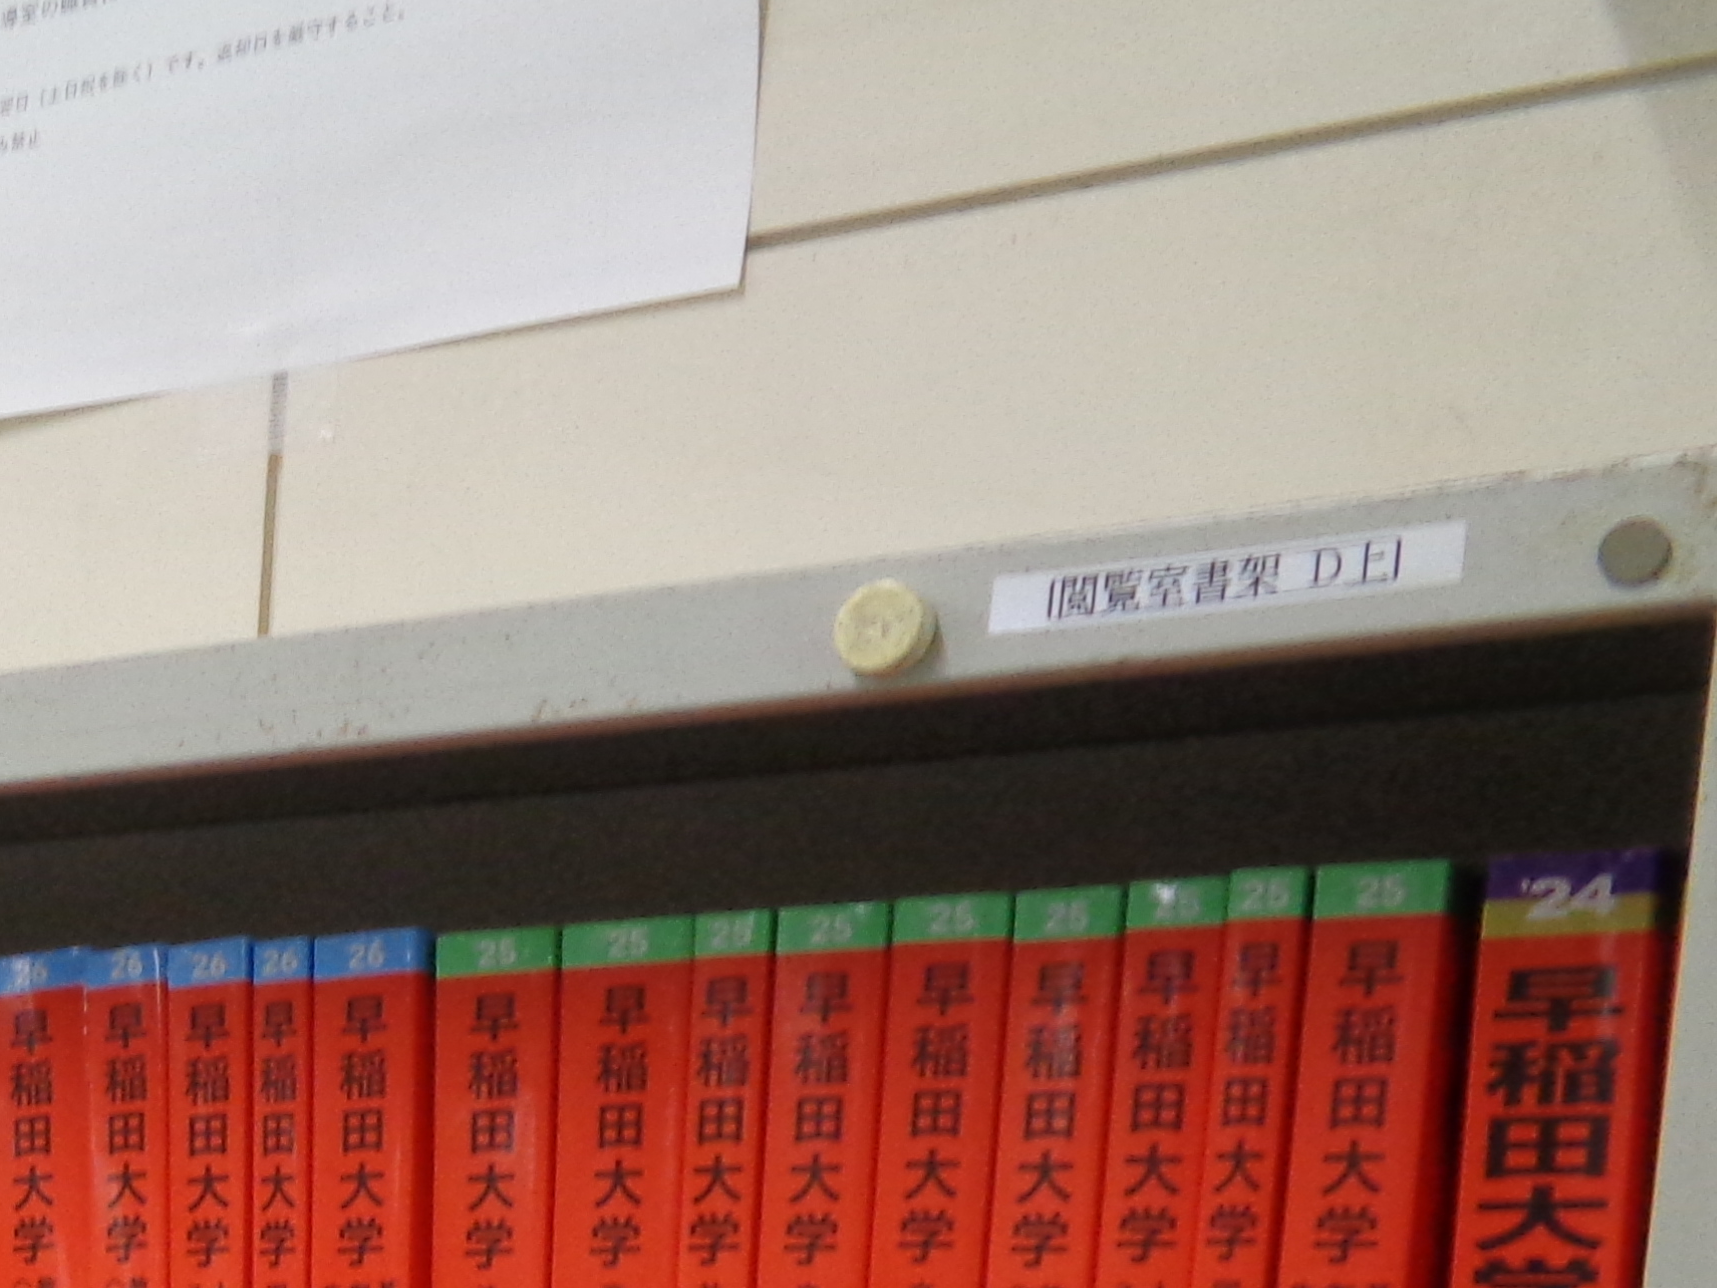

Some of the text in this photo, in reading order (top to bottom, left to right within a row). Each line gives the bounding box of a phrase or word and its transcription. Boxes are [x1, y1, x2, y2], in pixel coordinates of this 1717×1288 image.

[463, 992, 520, 1271] 早稲田大学
[590, 984, 649, 1271] 早稲田大学
[687, 976, 751, 1271] 早稲田大学
[783, 969, 853, 1265] 早稲田大学
[896, 958, 972, 1265] 早稲田大学
[1009, 960, 1086, 1267] 早稲田大学
[1116, 949, 1196, 1265] 早稲田大学
[1204, 940, 1283, 1261] 早稲田大学
[1313, 940, 1402, 1265] 早稲田大学
